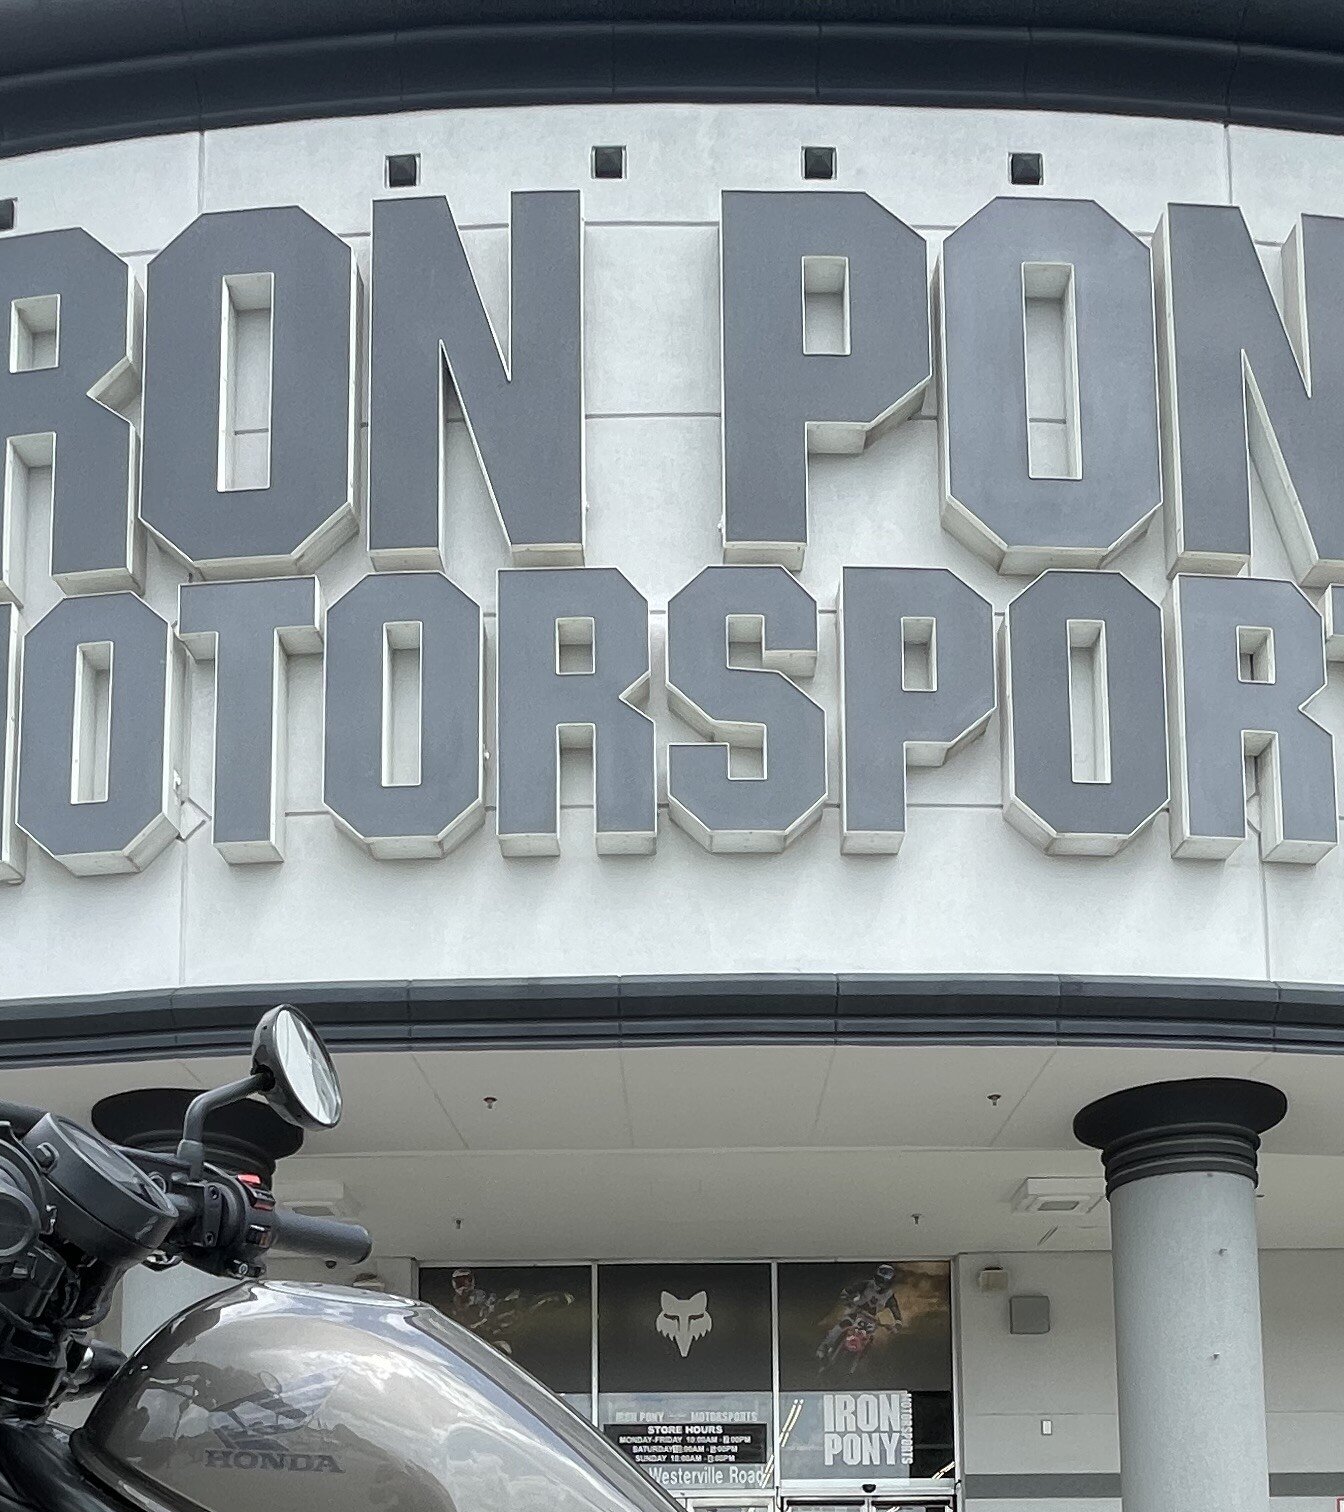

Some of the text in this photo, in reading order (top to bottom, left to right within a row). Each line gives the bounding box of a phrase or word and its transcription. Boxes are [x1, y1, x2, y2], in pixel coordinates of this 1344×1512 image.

[823, 1394, 901, 1432] IRON
[647, 1425, 723, 1434] STORE HOURS
[900, 1393, 913, 1465] MOTORSPORTS
[205, 1449, 346, 1473] HONDA
[632, 1445, 673, 1453] SATURDAY
[824, 1432, 901, 1466] PONY
[648, 1466, 764, 1485] Westerville Road
